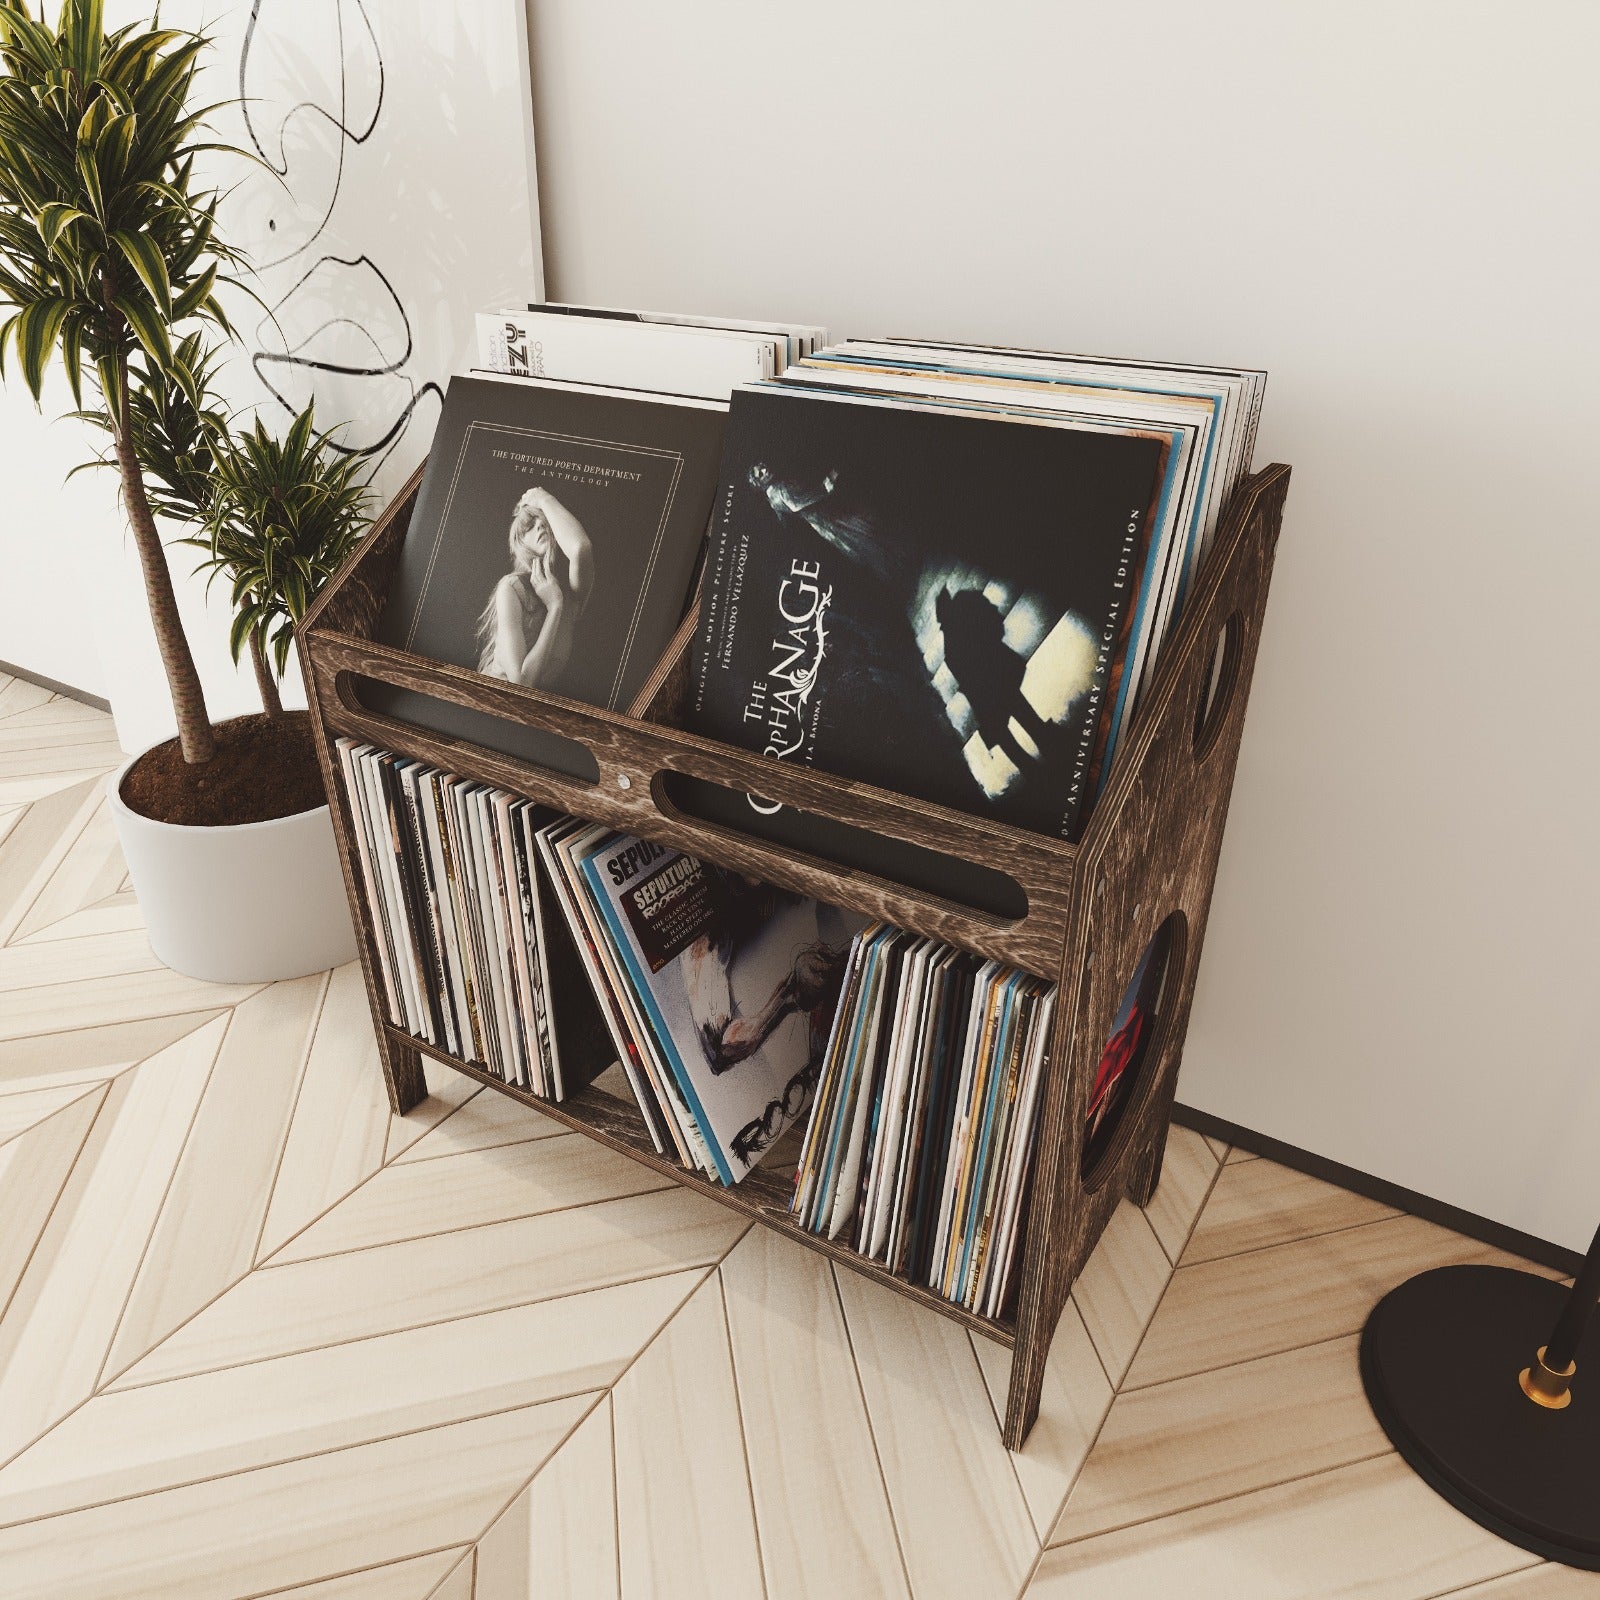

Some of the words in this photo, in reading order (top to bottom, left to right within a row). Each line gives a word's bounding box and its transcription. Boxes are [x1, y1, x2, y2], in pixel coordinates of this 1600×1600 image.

[492, 449, 508, 461] THE
[509, 452, 554, 467] TORTURED
[555, 459, 582, 472] POETS
[583, 463, 642, 482] DEPARTMENT
[514, 464, 535, 474] THE
[541, 469, 611, 488] ANTHOLOGY
[696, 651, 710, 712] ORIGINAL
[706, 592, 718, 644] MOTION
[715, 531, 727, 586] PICTURE
[721, 605, 738, 670] FERNANDO
[1066, 683, 1101, 805] ANNIVERSARY
[1095, 602, 1119, 674] SPECIAL
[1113, 508, 1140, 589] EDITION
[743, 680, 768, 723] THE
[809, 699, 822, 740] BAYONA
